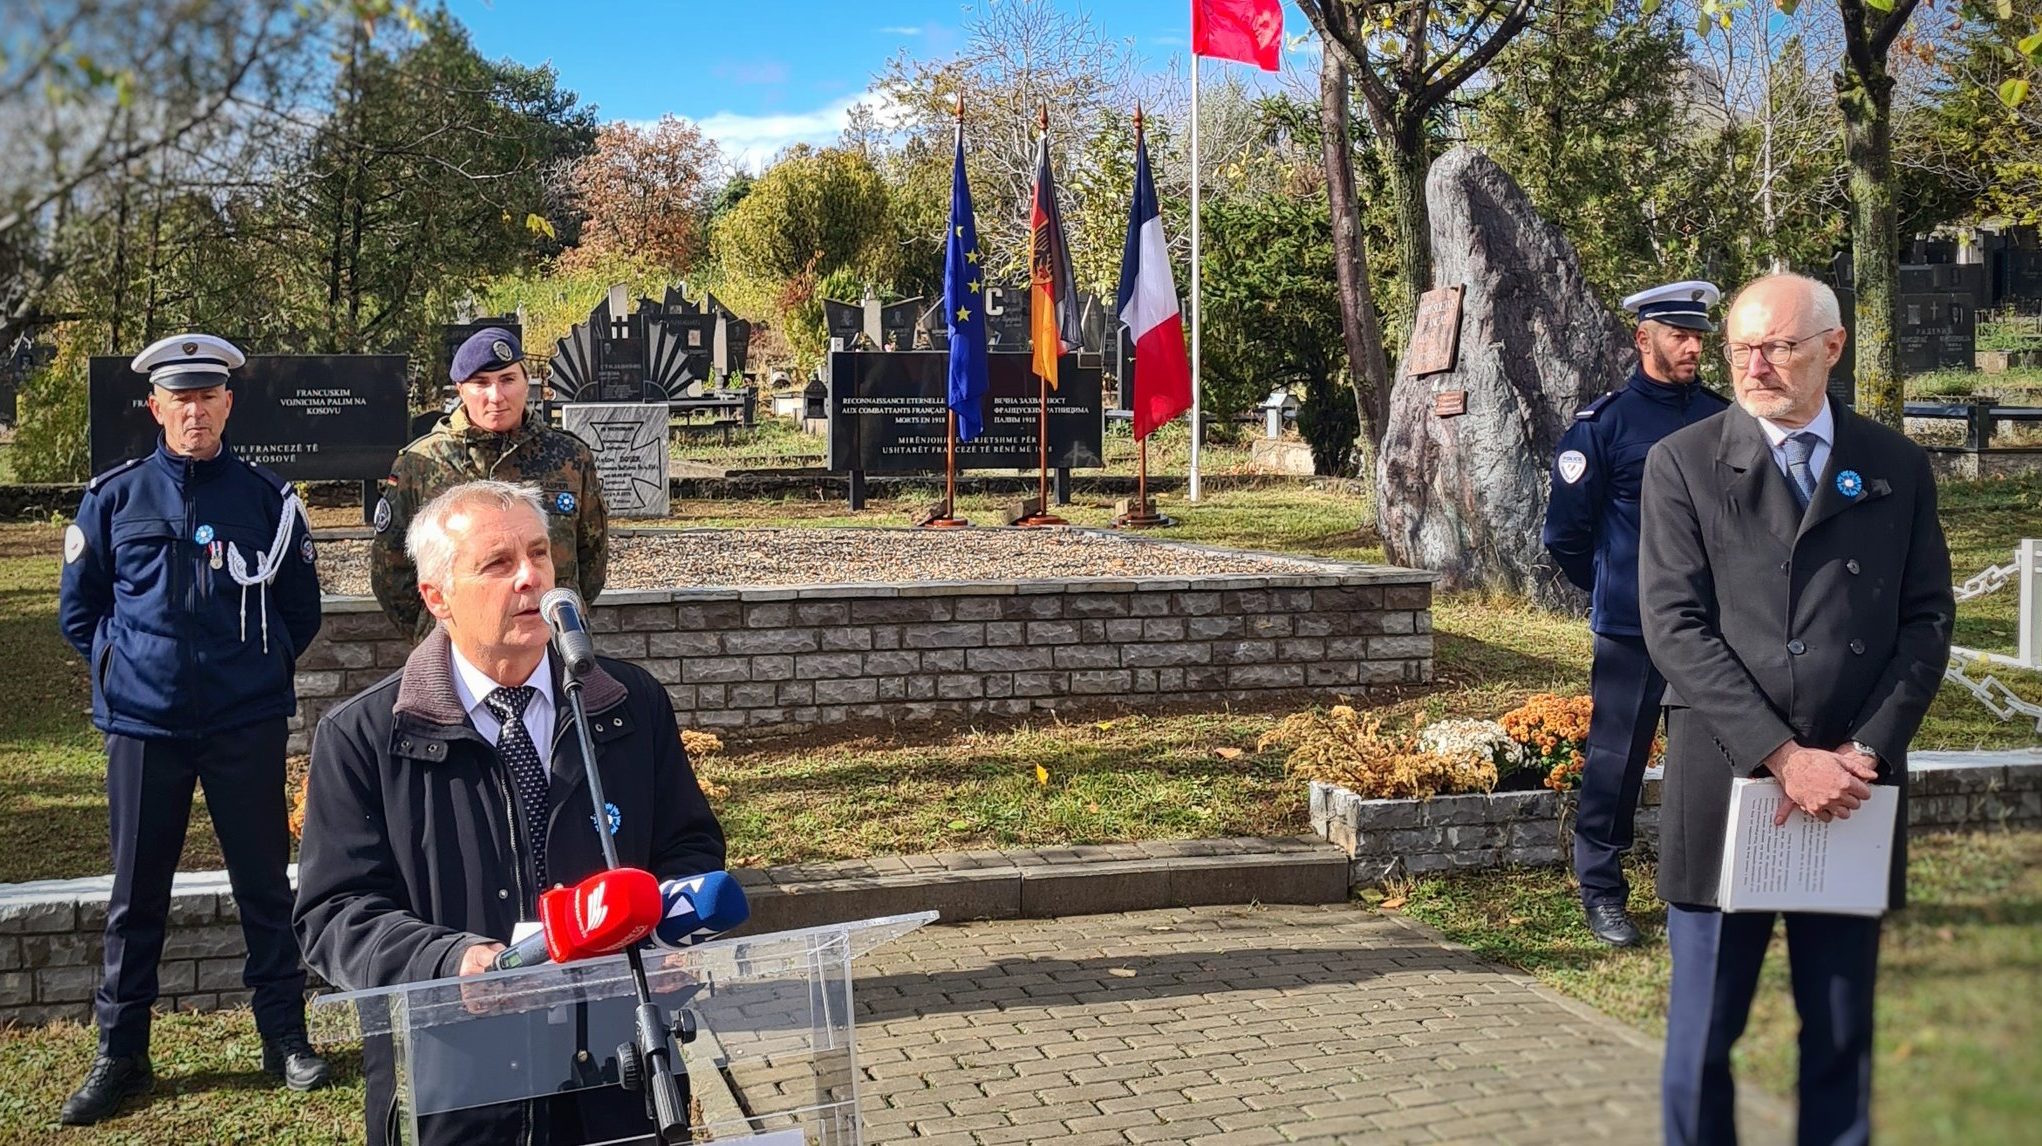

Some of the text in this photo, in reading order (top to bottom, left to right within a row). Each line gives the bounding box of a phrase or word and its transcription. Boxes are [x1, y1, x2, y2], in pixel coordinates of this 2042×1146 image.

[296, 389, 351, 397] FRANCUSKIM
[280, 399, 325, 407] VOJNICIMA
[354, 398, 367, 406] NA
[306, 407, 341, 415] KOSOVU
[912, 407, 946, 415] FRANÇAIS
[1021, 435, 1037, 443] PËR
[249, 444, 302, 453] FRANCEZË
[306, 443, 319, 453] TË
[931, 445, 977, 453] FRACEZË
[993, 445, 1017, 453] RËNË
[1019, 445, 1032, 453] MË
[255, 454, 296, 463] KOSOVË
